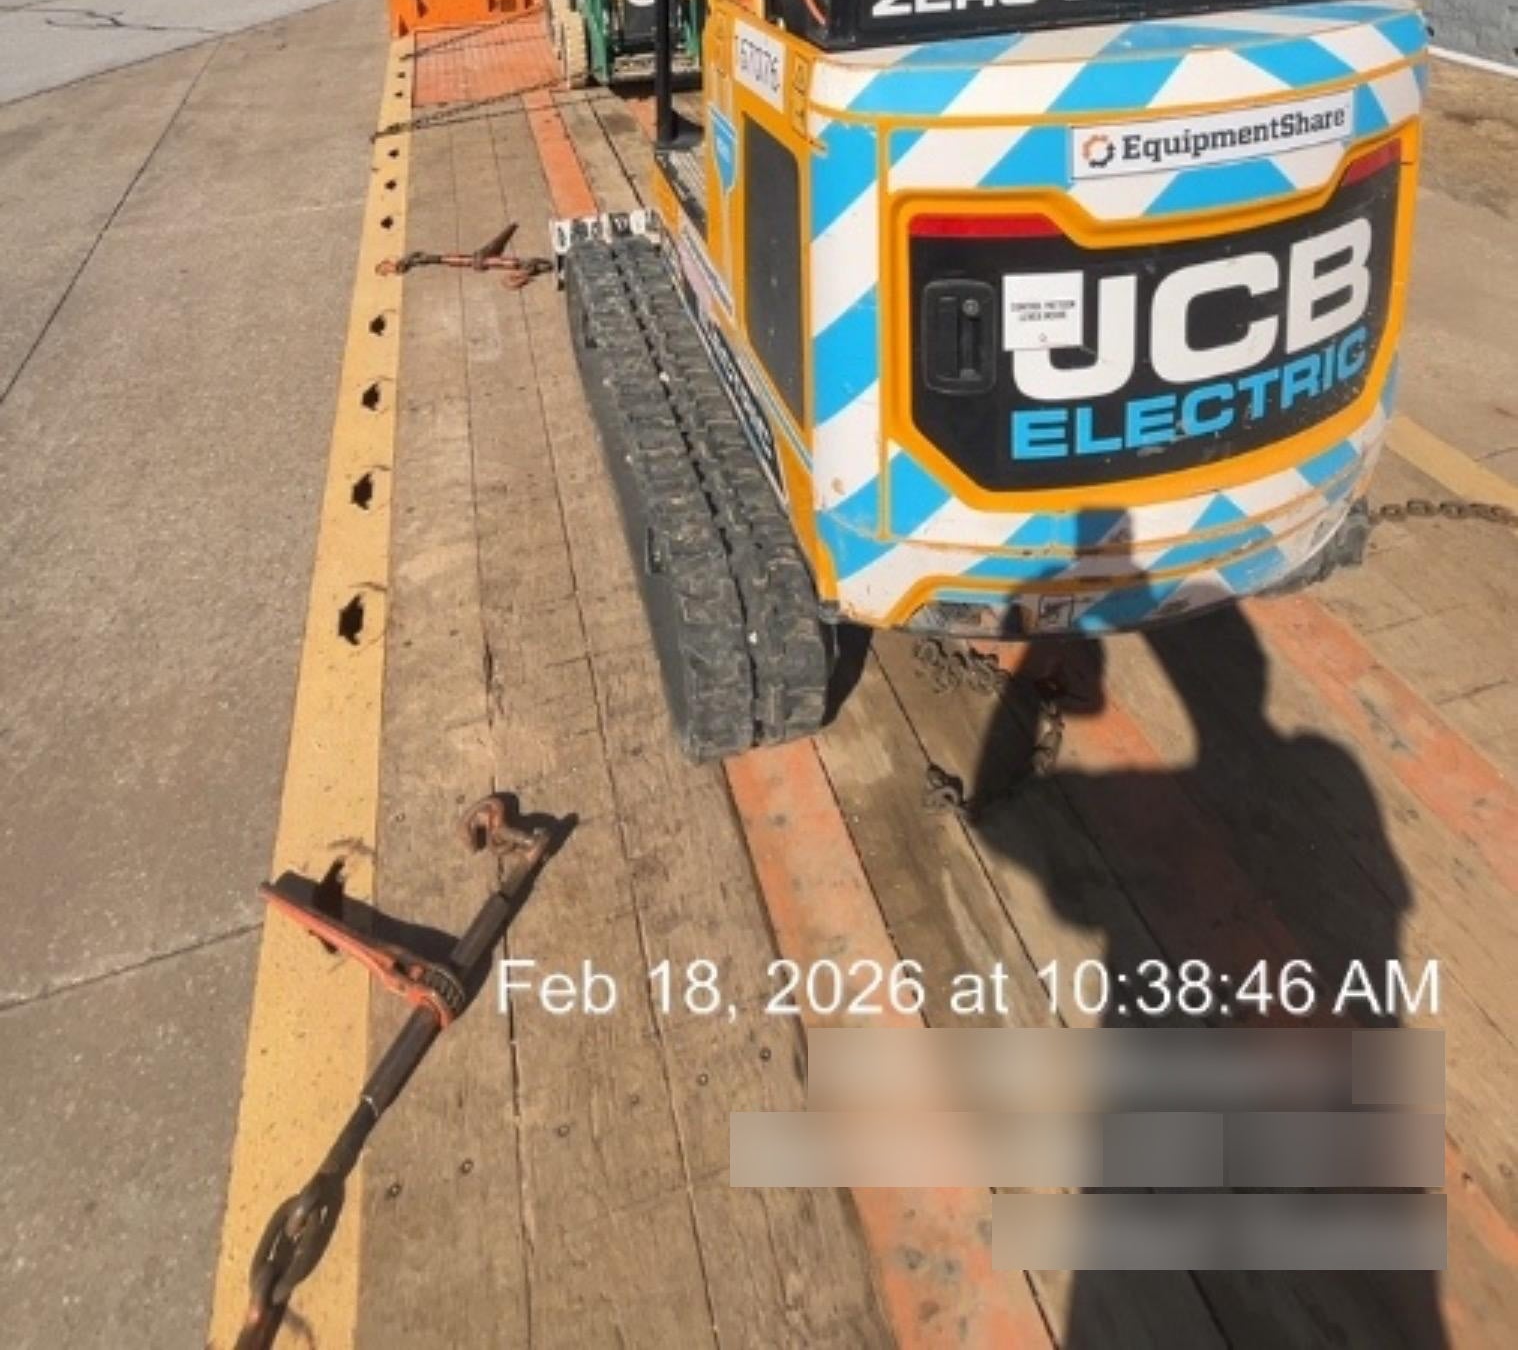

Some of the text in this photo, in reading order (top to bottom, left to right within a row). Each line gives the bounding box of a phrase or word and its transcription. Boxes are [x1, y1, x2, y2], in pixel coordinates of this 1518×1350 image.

[1121, 107, 1346, 162] EquipmentShare
[1011, 216, 1372, 402] JCB
[1010, 327, 1367, 461] ELECTRIC
